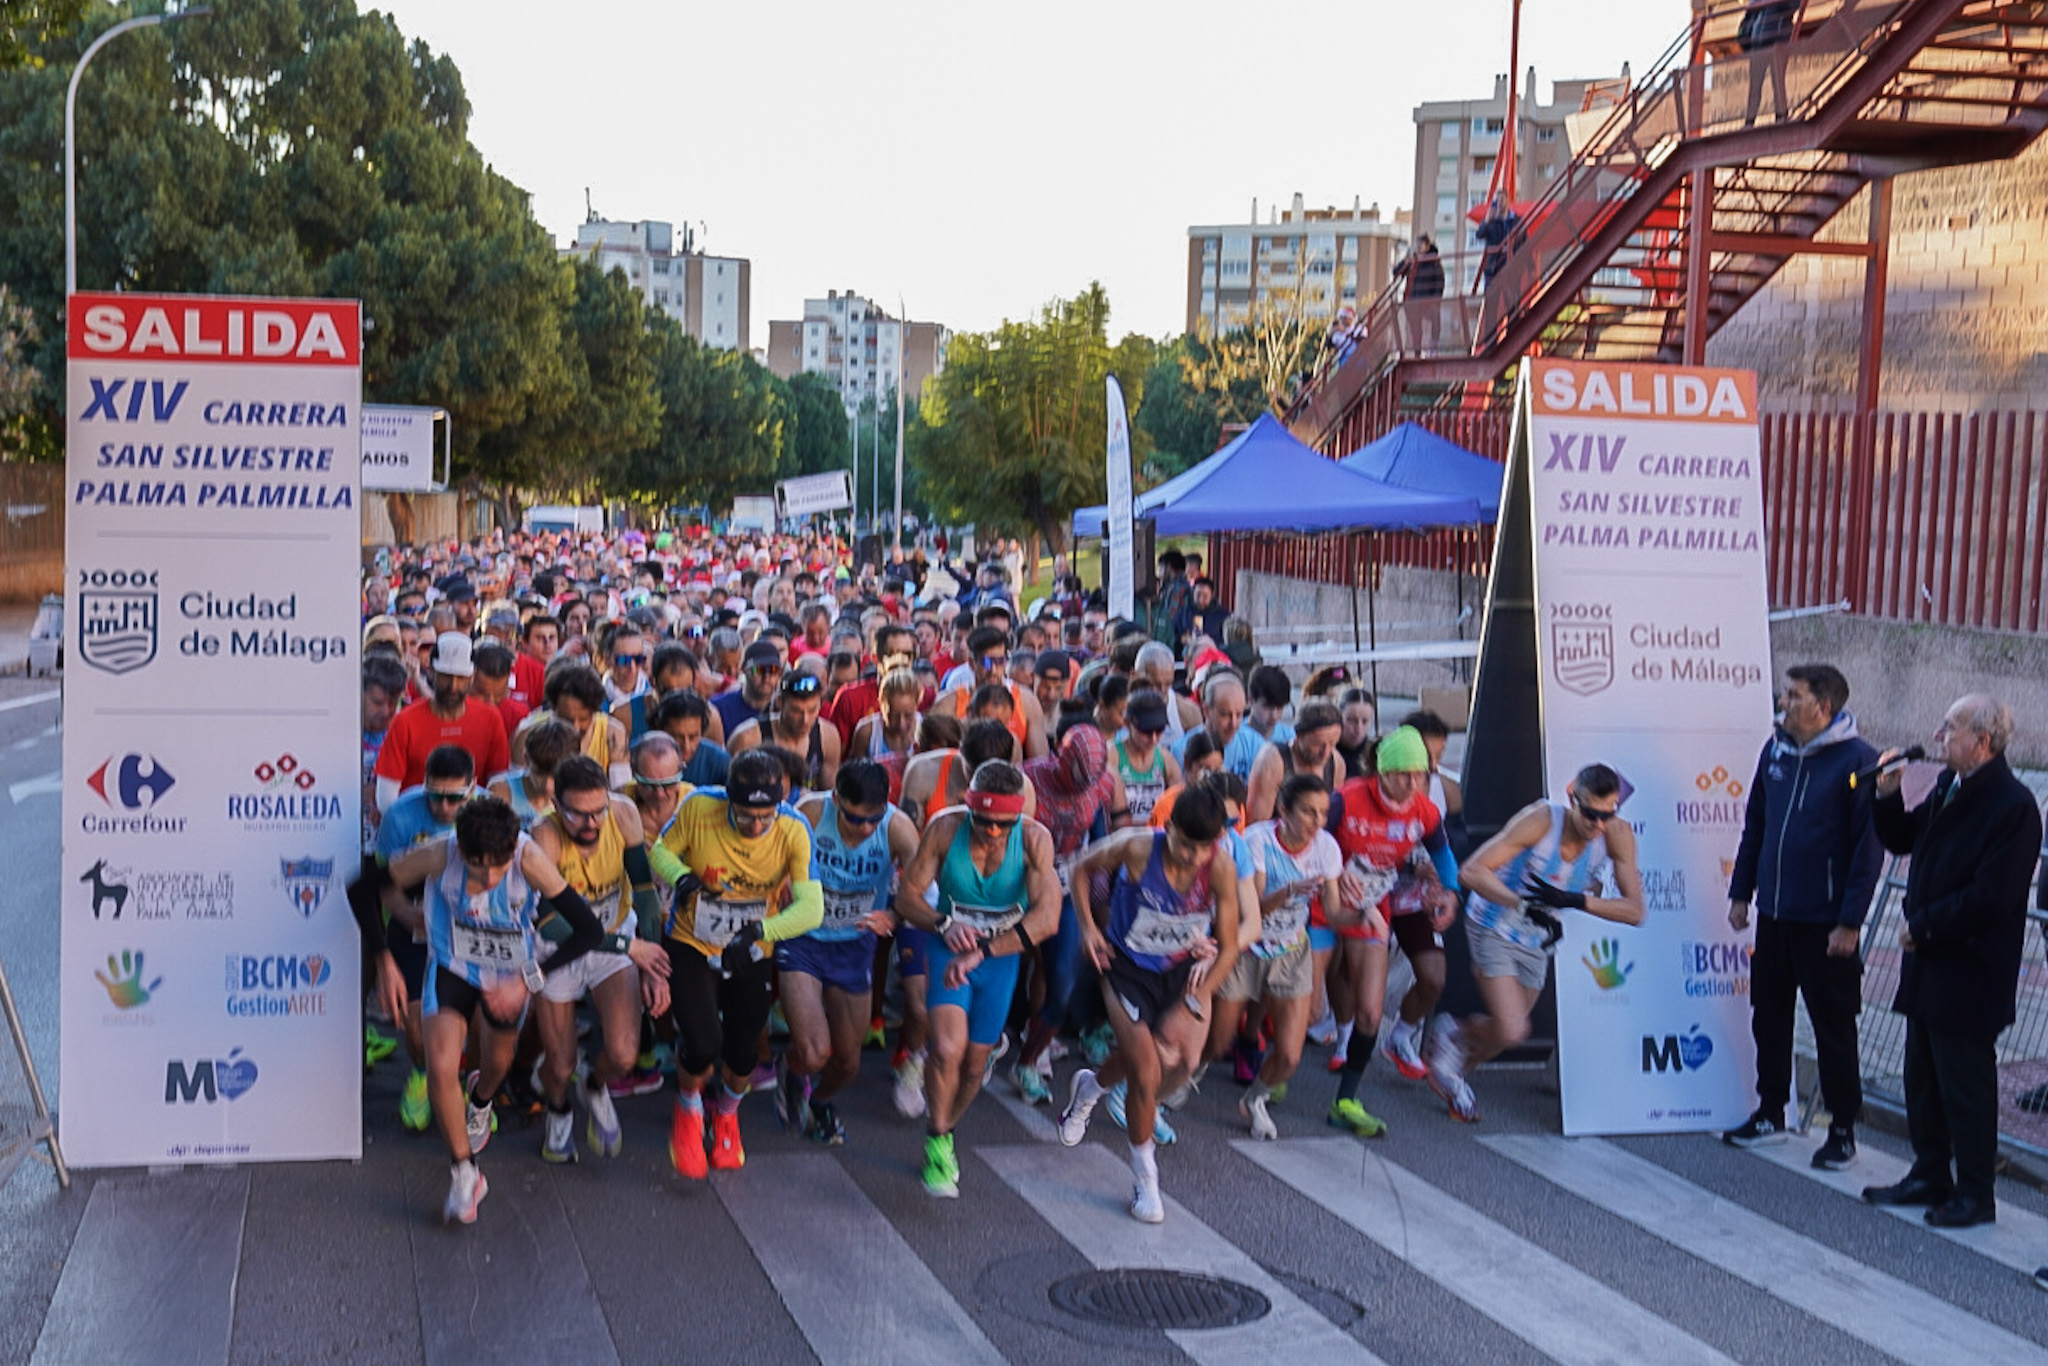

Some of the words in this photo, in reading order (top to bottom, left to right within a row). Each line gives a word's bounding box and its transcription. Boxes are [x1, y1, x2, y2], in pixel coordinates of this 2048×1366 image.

[83, 306, 347, 358] SALIDA
[79, 378, 190, 422] XIV
[203, 401, 347, 428] CARRERA
[1543, 368, 1747, 418] SALIDA
[97, 443, 163, 469] SAN
[172, 445, 334, 472] SILVESTRE
[362, 451, 409, 467] ADOS
[1544, 432, 1627, 474] XIV
[1639, 455, 1751, 480] CARRERA
[74, 481, 186, 508] PALMA
[198, 484, 353, 510] PALMILLA
[1558, 491, 1610, 514] SAN
[1617, 493, 1742, 519] SILVESTRE
[1544, 524, 1630, 548] PALMA
[1638, 527, 1759, 552] PALMILLA
[180, 592, 296, 621] Ciudad
[180, 630, 220, 657] de
[231, 630, 346, 664] Málaga
[1630, 624, 1721, 650] Ciudad
[1632, 658, 1663, 682] de
[1671, 658, 1761, 688] Málaga
[228, 793, 342, 820] ROSALEDA
[1677, 801, 1747, 824] ROSALE
[82, 812, 187, 834] Carrefour
[242, 954, 297, 990] BCM
[1695, 942, 1739, 974] BCM
[1685, 976, 1750, 997] GestionAR
